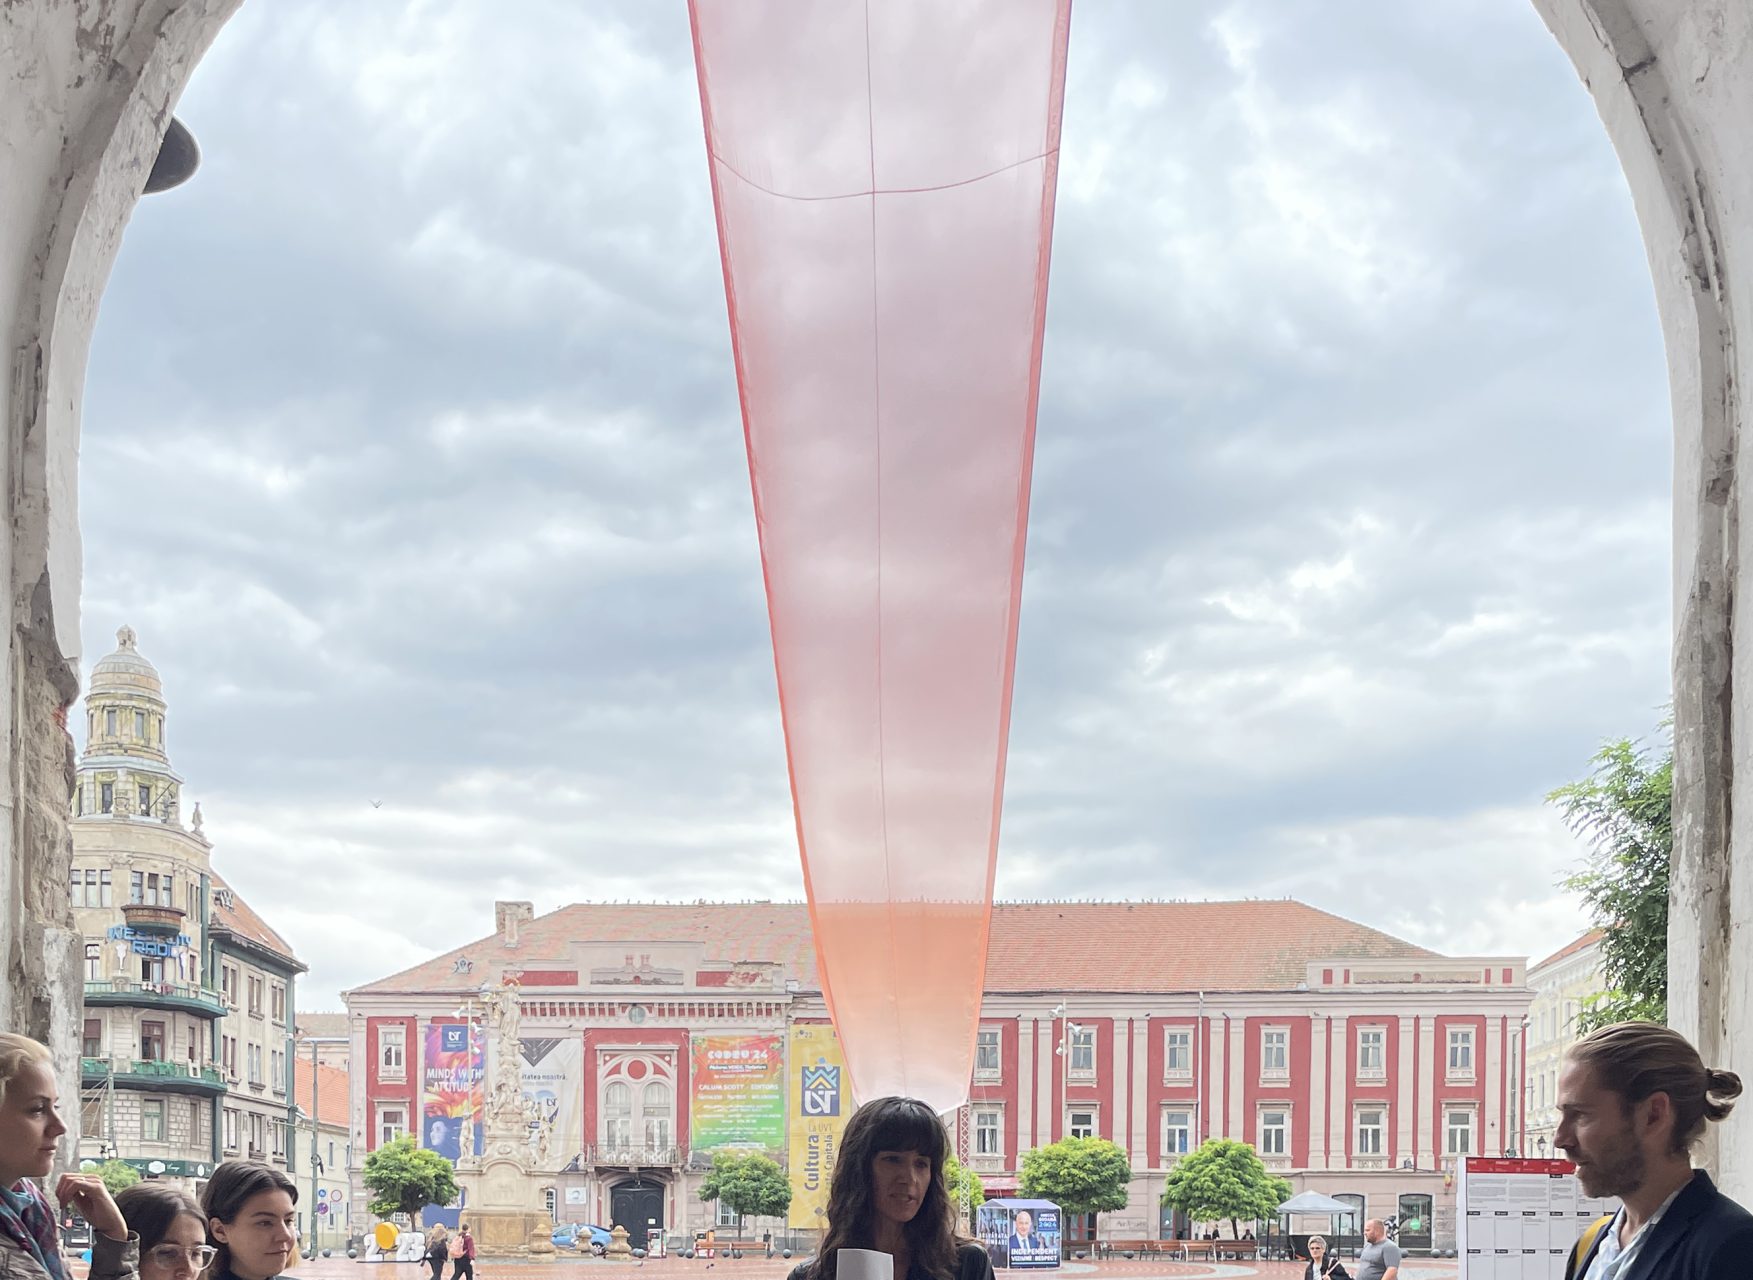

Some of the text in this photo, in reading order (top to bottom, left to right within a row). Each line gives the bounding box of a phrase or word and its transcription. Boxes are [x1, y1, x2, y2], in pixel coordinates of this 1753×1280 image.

[426, 1068, 482, 1079] MINDS WTH
[804, 1134, 819, 1191] Cultura
